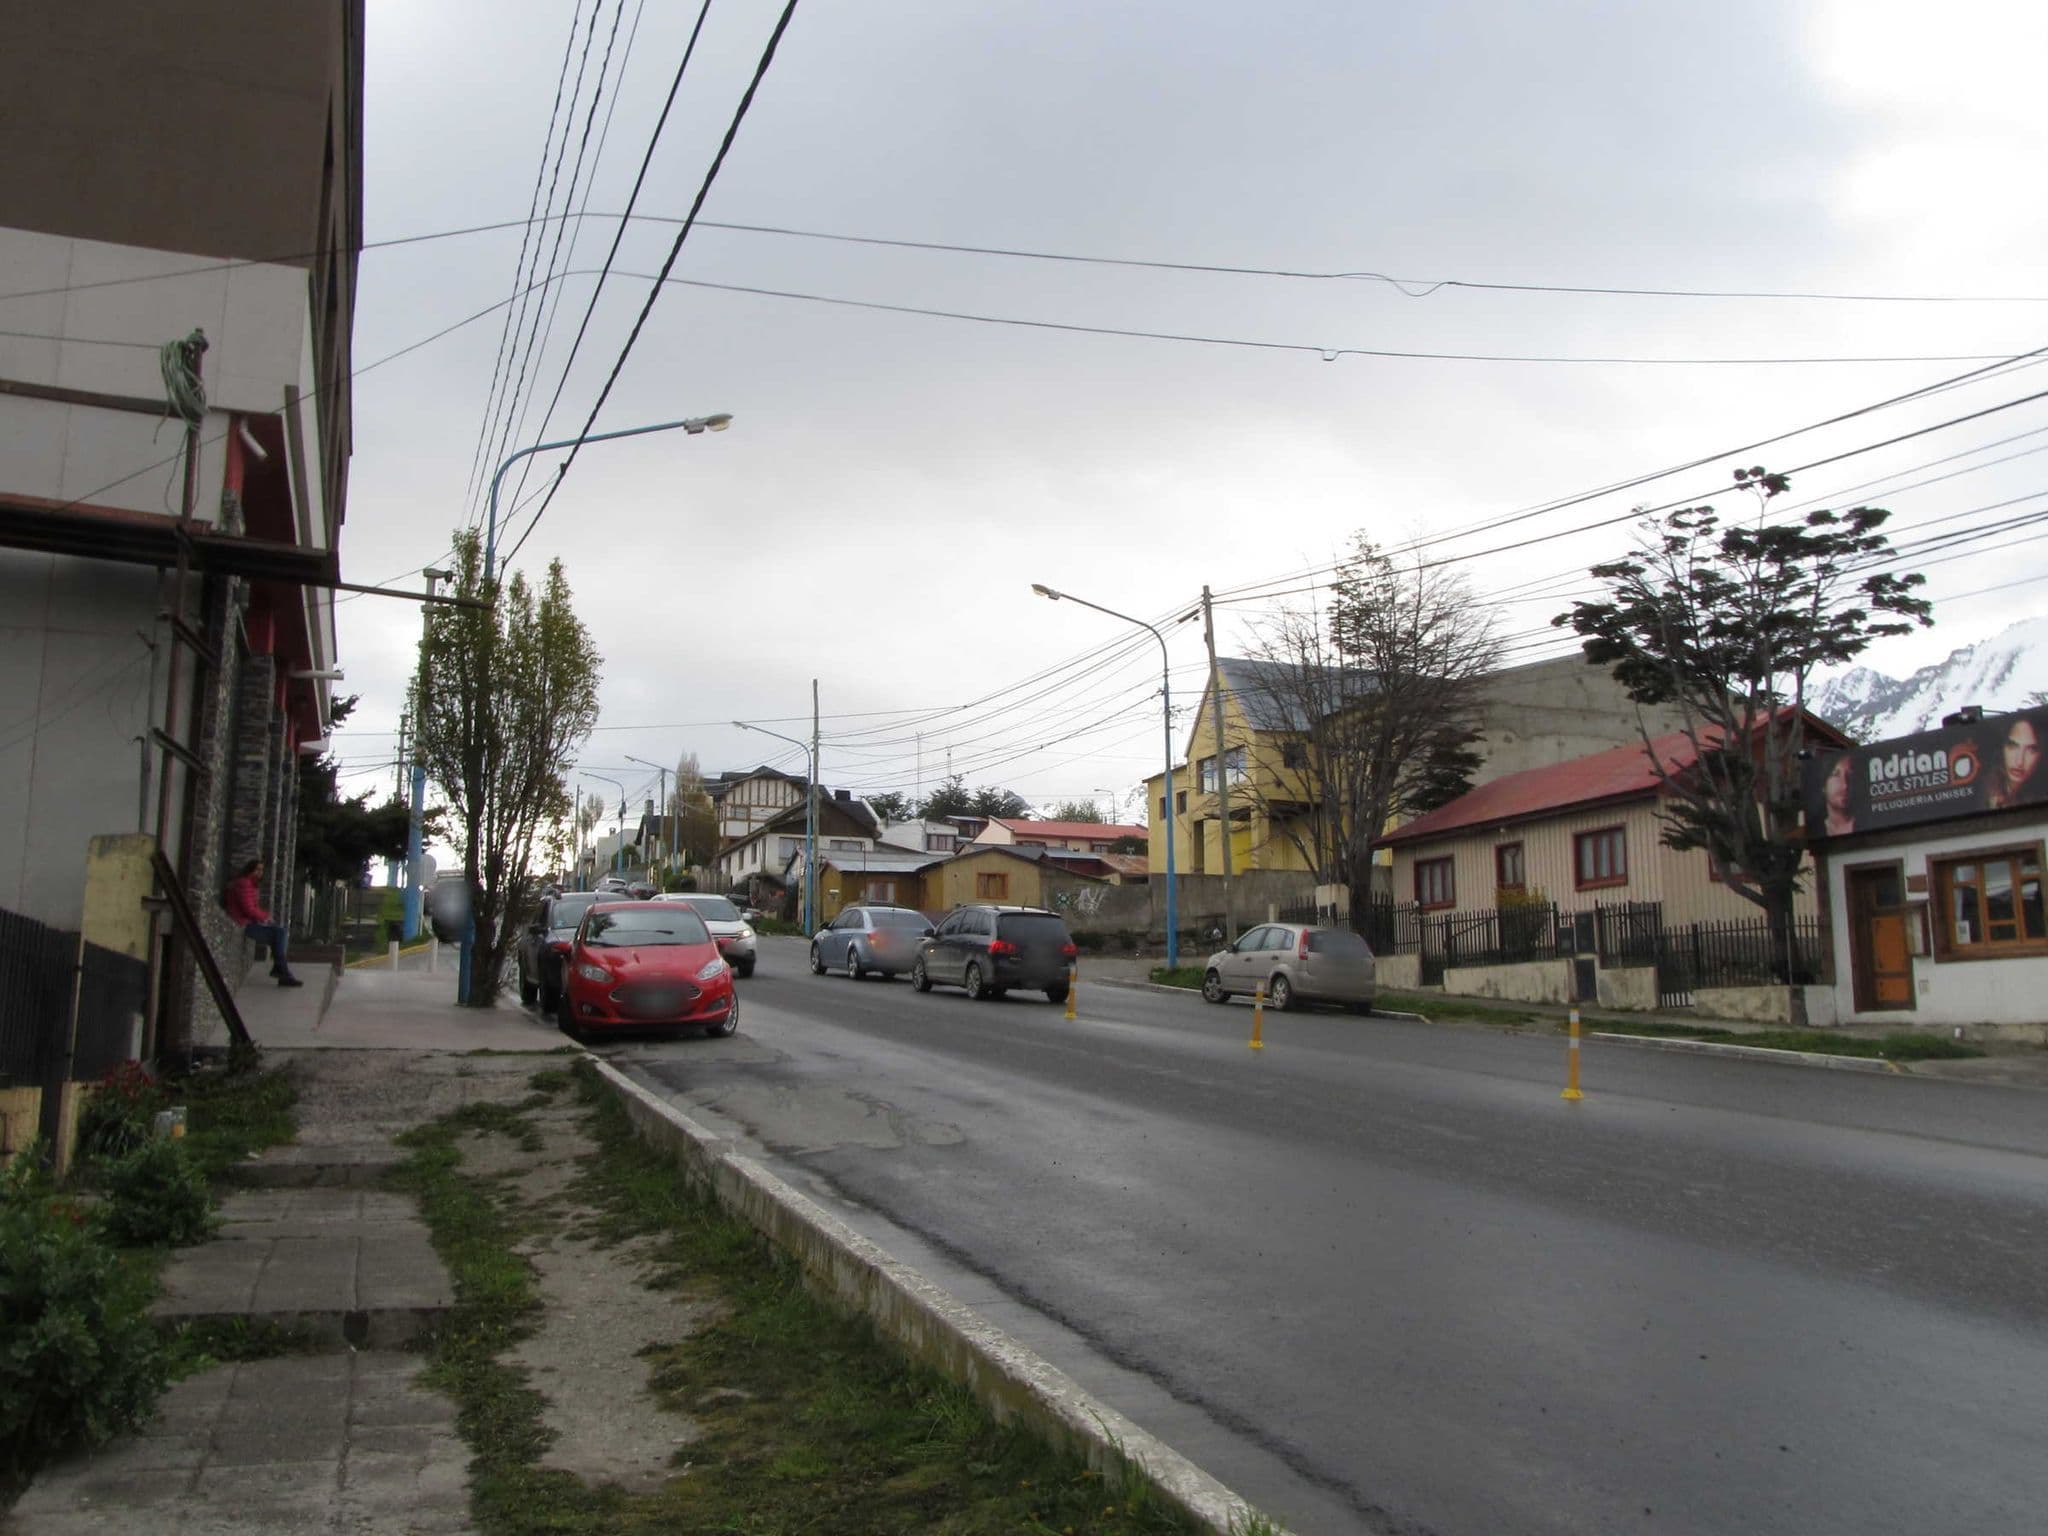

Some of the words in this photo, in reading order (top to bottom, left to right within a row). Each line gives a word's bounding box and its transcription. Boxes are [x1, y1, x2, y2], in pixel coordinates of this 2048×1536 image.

[1869, 749, 1947, 782] Adrian
[1870, 781, 1901, 797] COOL
[1903, 771, 1949, 790] STYLES
[1871, 794, 1934, 812] PELUQUERIA
[1935, 786, 1974, 800] UNISEX
